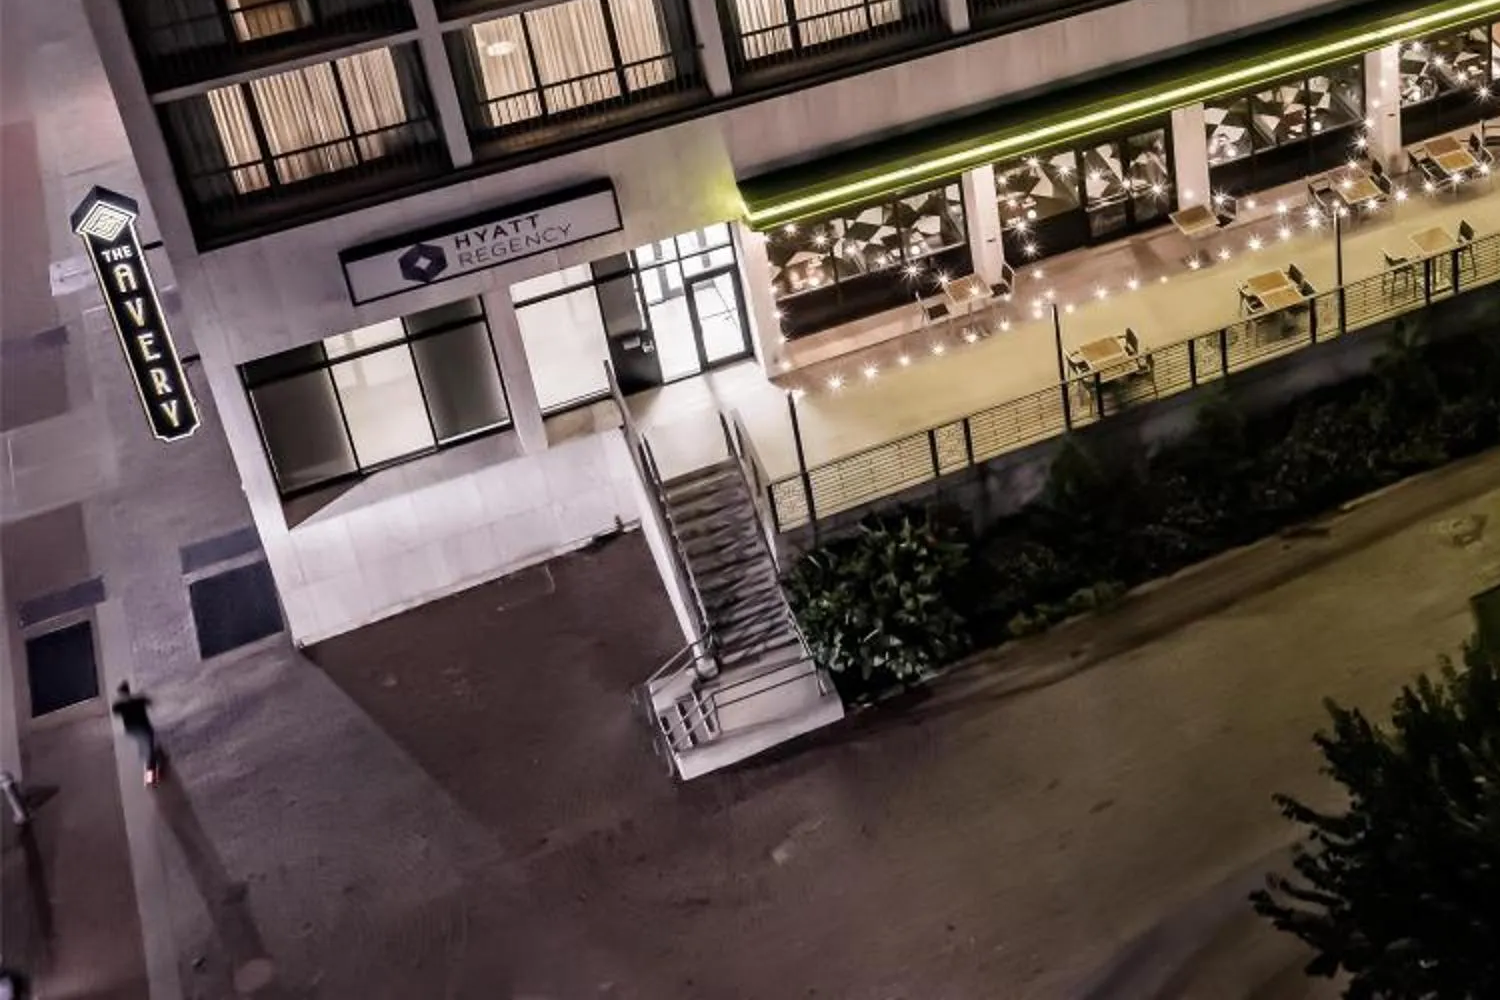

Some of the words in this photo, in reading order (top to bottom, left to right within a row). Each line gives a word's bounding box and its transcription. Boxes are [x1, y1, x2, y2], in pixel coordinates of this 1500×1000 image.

[453, 213, 540, 249] HYATT
[458, 223, 572, 267] REGENCY
[101, 245, 133, 263] THE
[112, 264, 181, 427] AVERY
